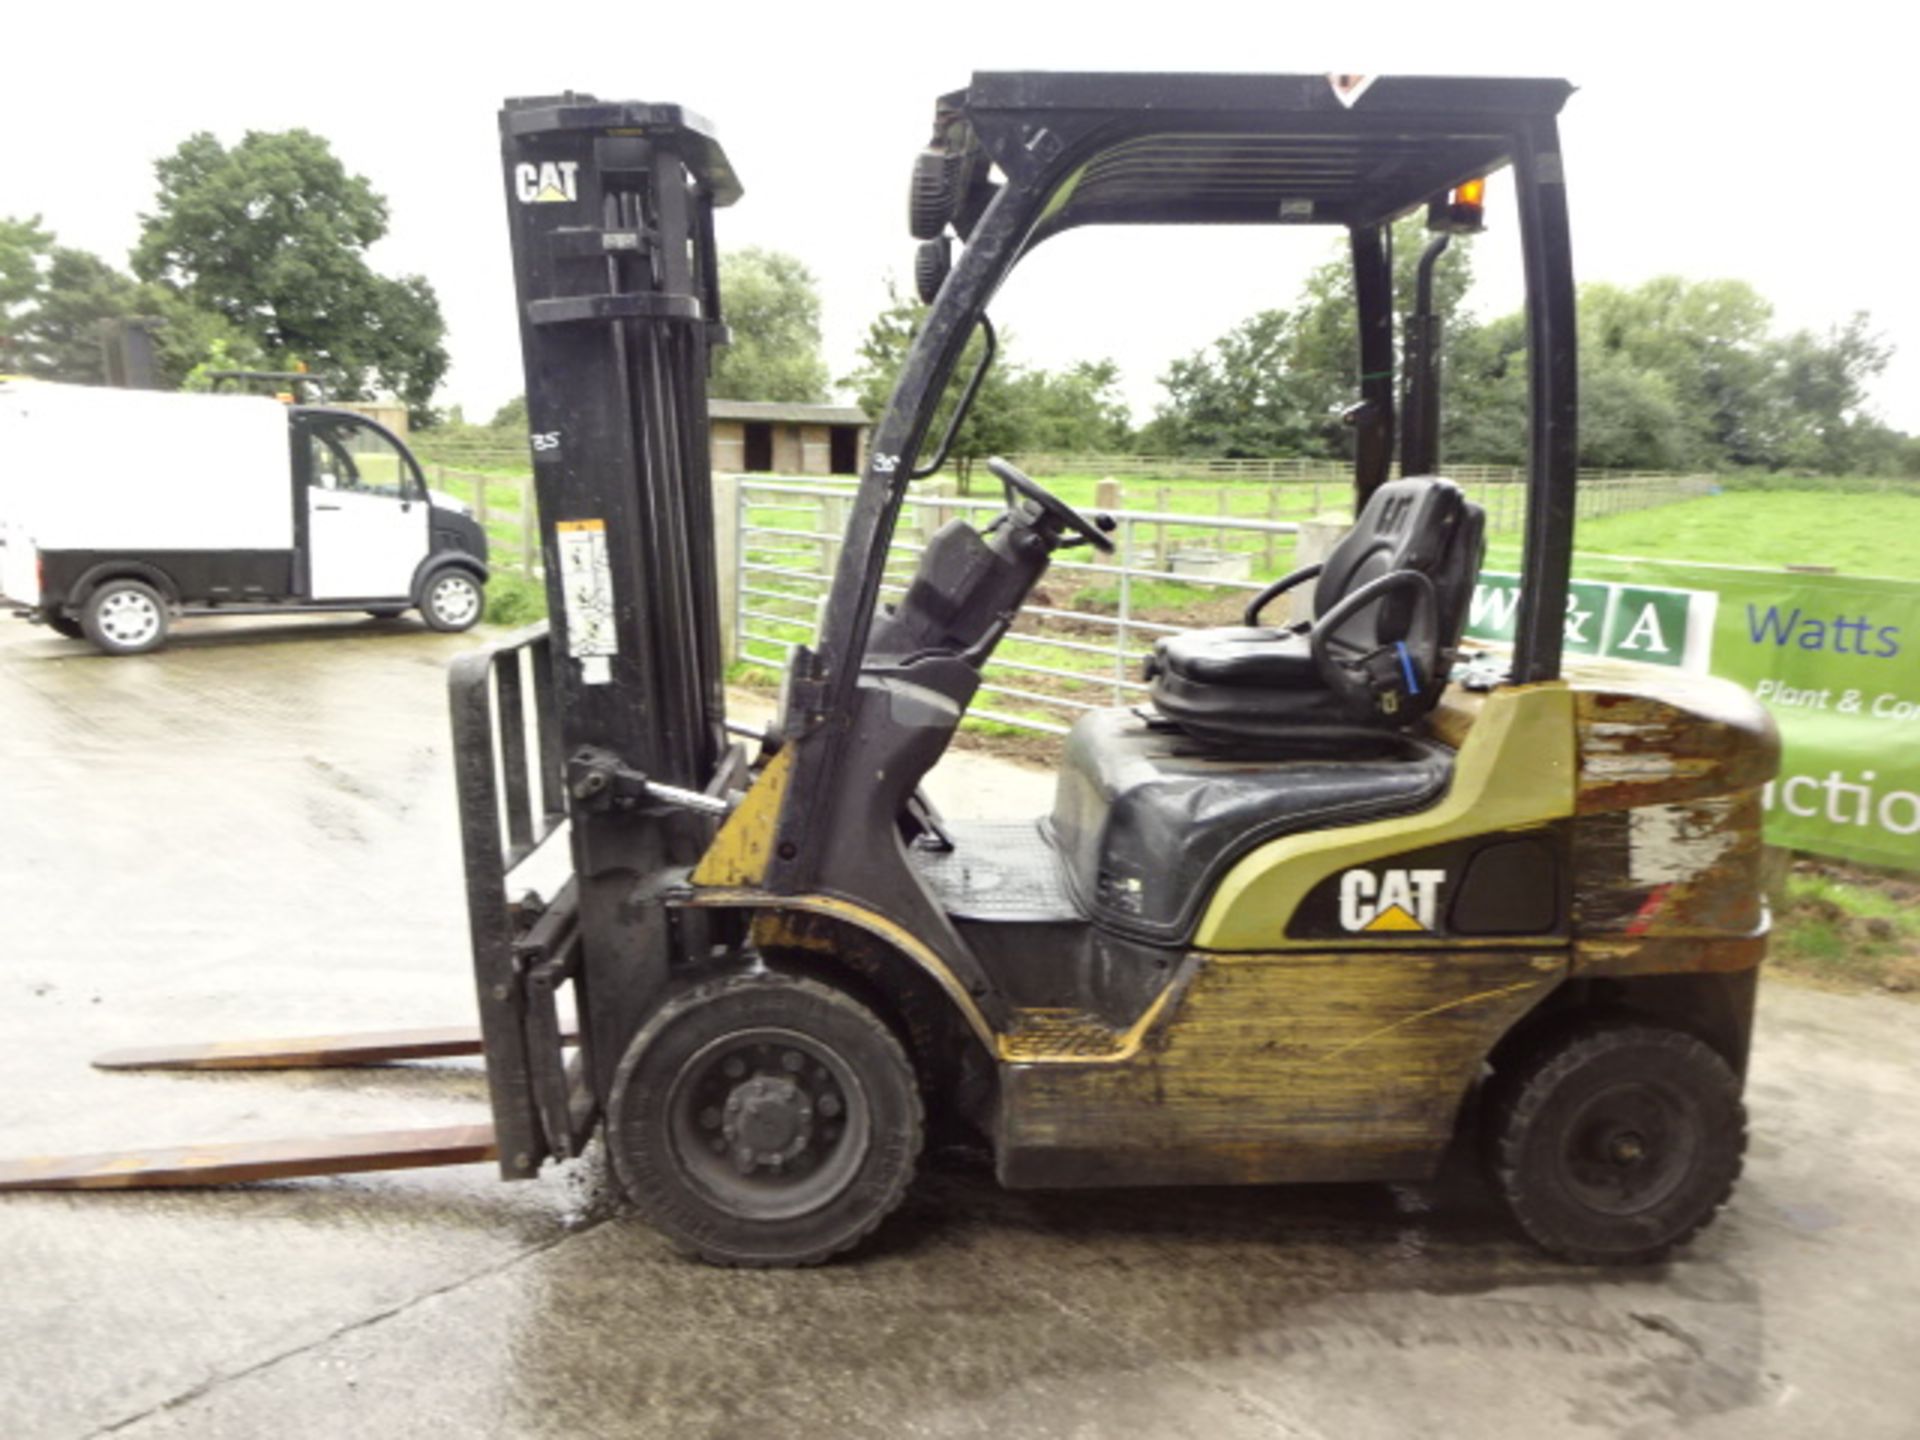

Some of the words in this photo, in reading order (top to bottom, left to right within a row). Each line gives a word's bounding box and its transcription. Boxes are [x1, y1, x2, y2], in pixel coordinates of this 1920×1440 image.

[515, 161, 578, 203] CAT
[1617, 602, 1671, 653] A
[1747, 603, 1900, 658] Watts
[1756, 679, 1831, 709] Plant
[1837, 689, 1862, 713] &
[1339, 869, 1446, 931] CAT
